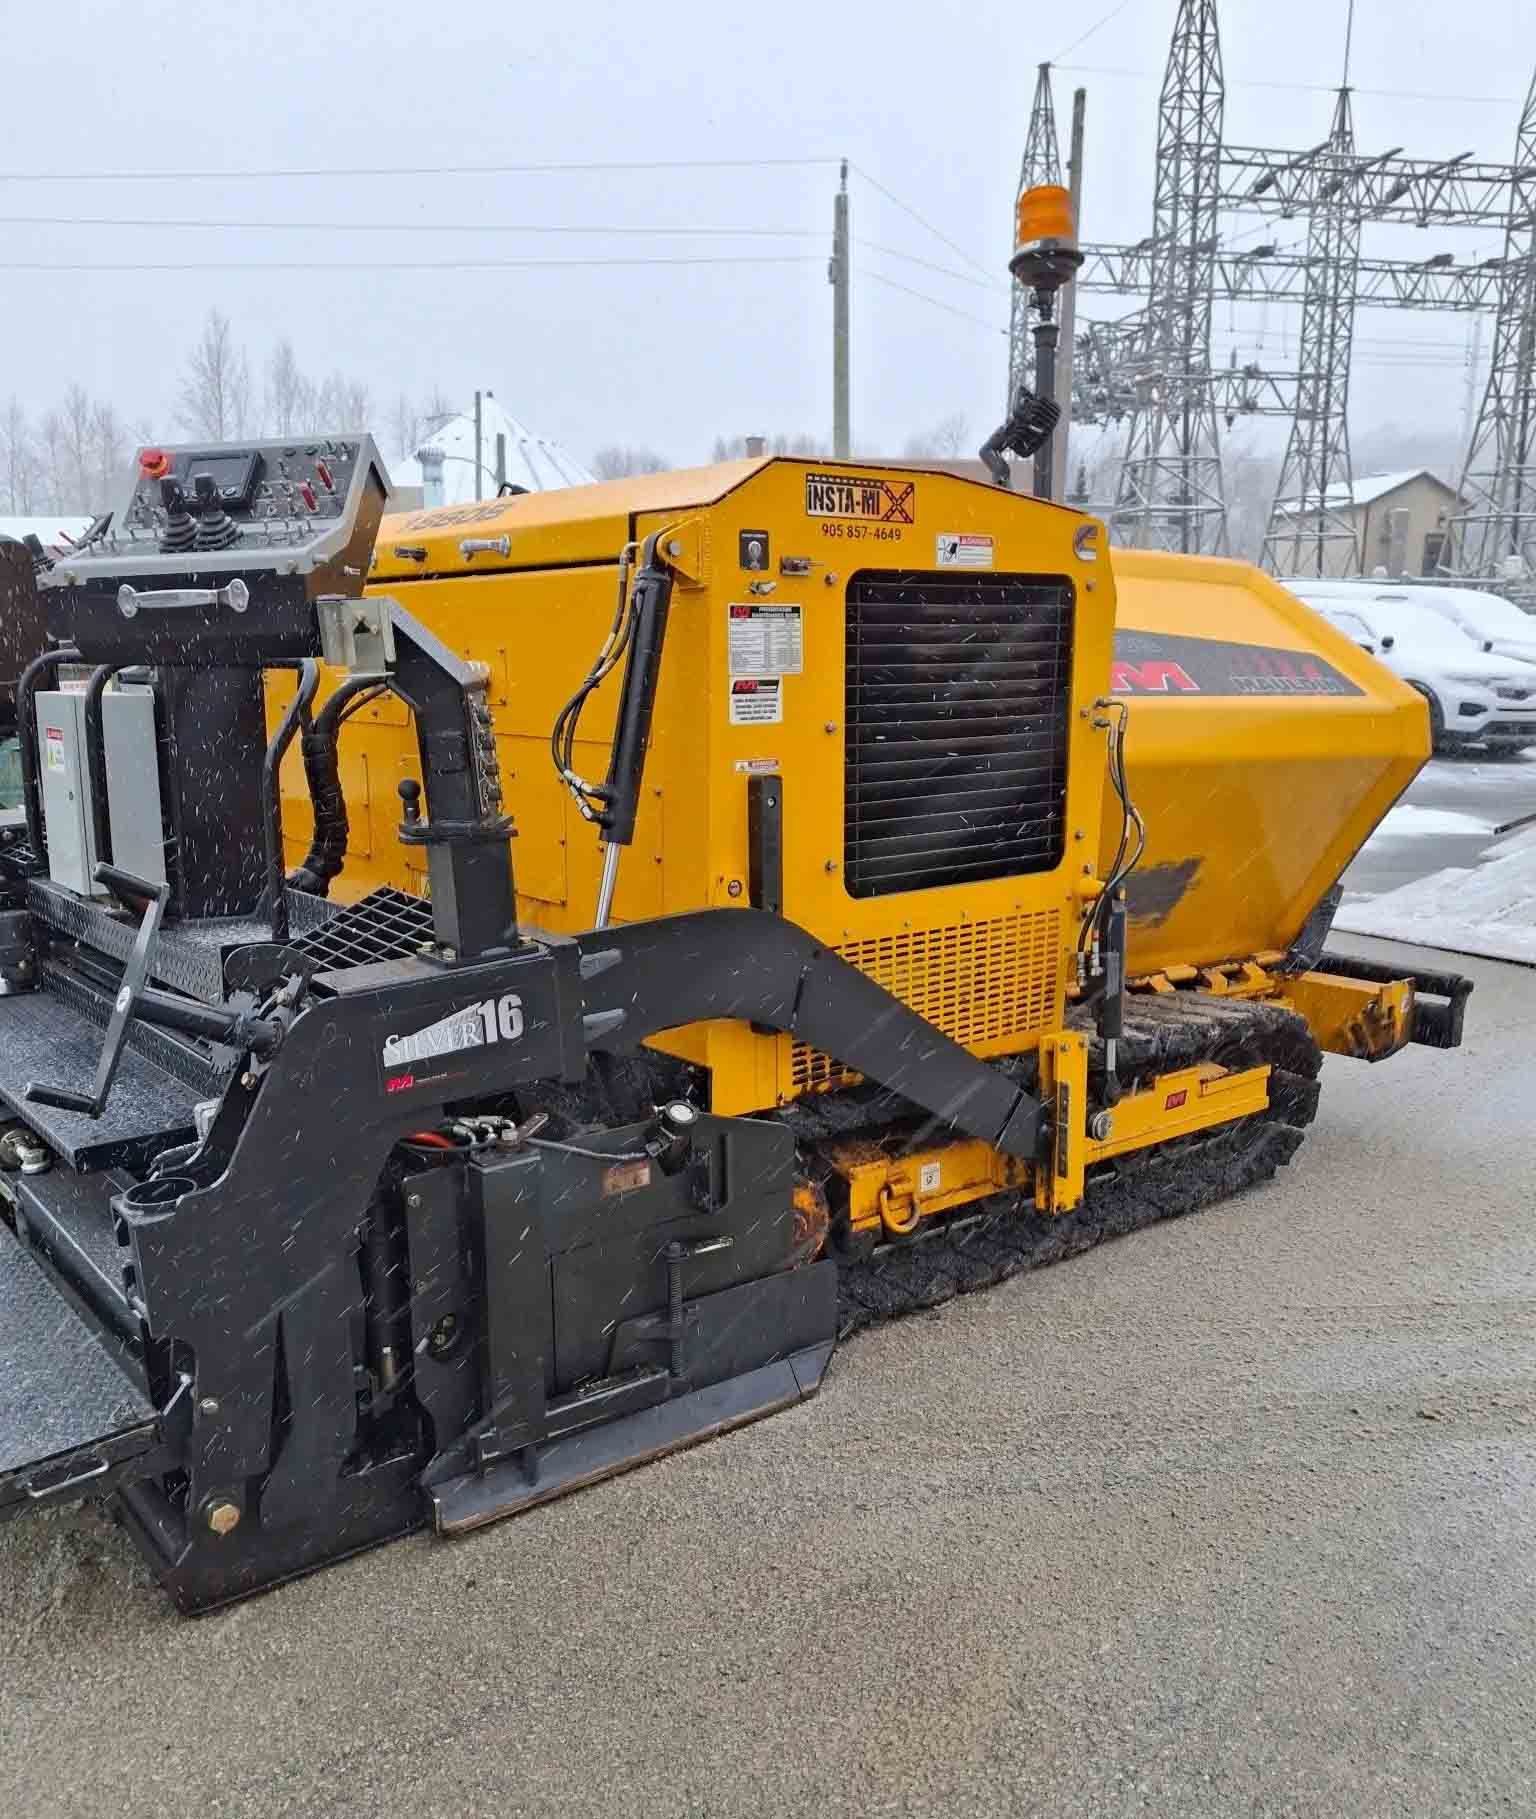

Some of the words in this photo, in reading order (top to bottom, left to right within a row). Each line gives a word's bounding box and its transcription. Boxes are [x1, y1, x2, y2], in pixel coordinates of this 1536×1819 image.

[822, 523, 843, 538] 905
[847, 525, 902, 541] 857-4649
[476, 994, 523, 1043] 16
